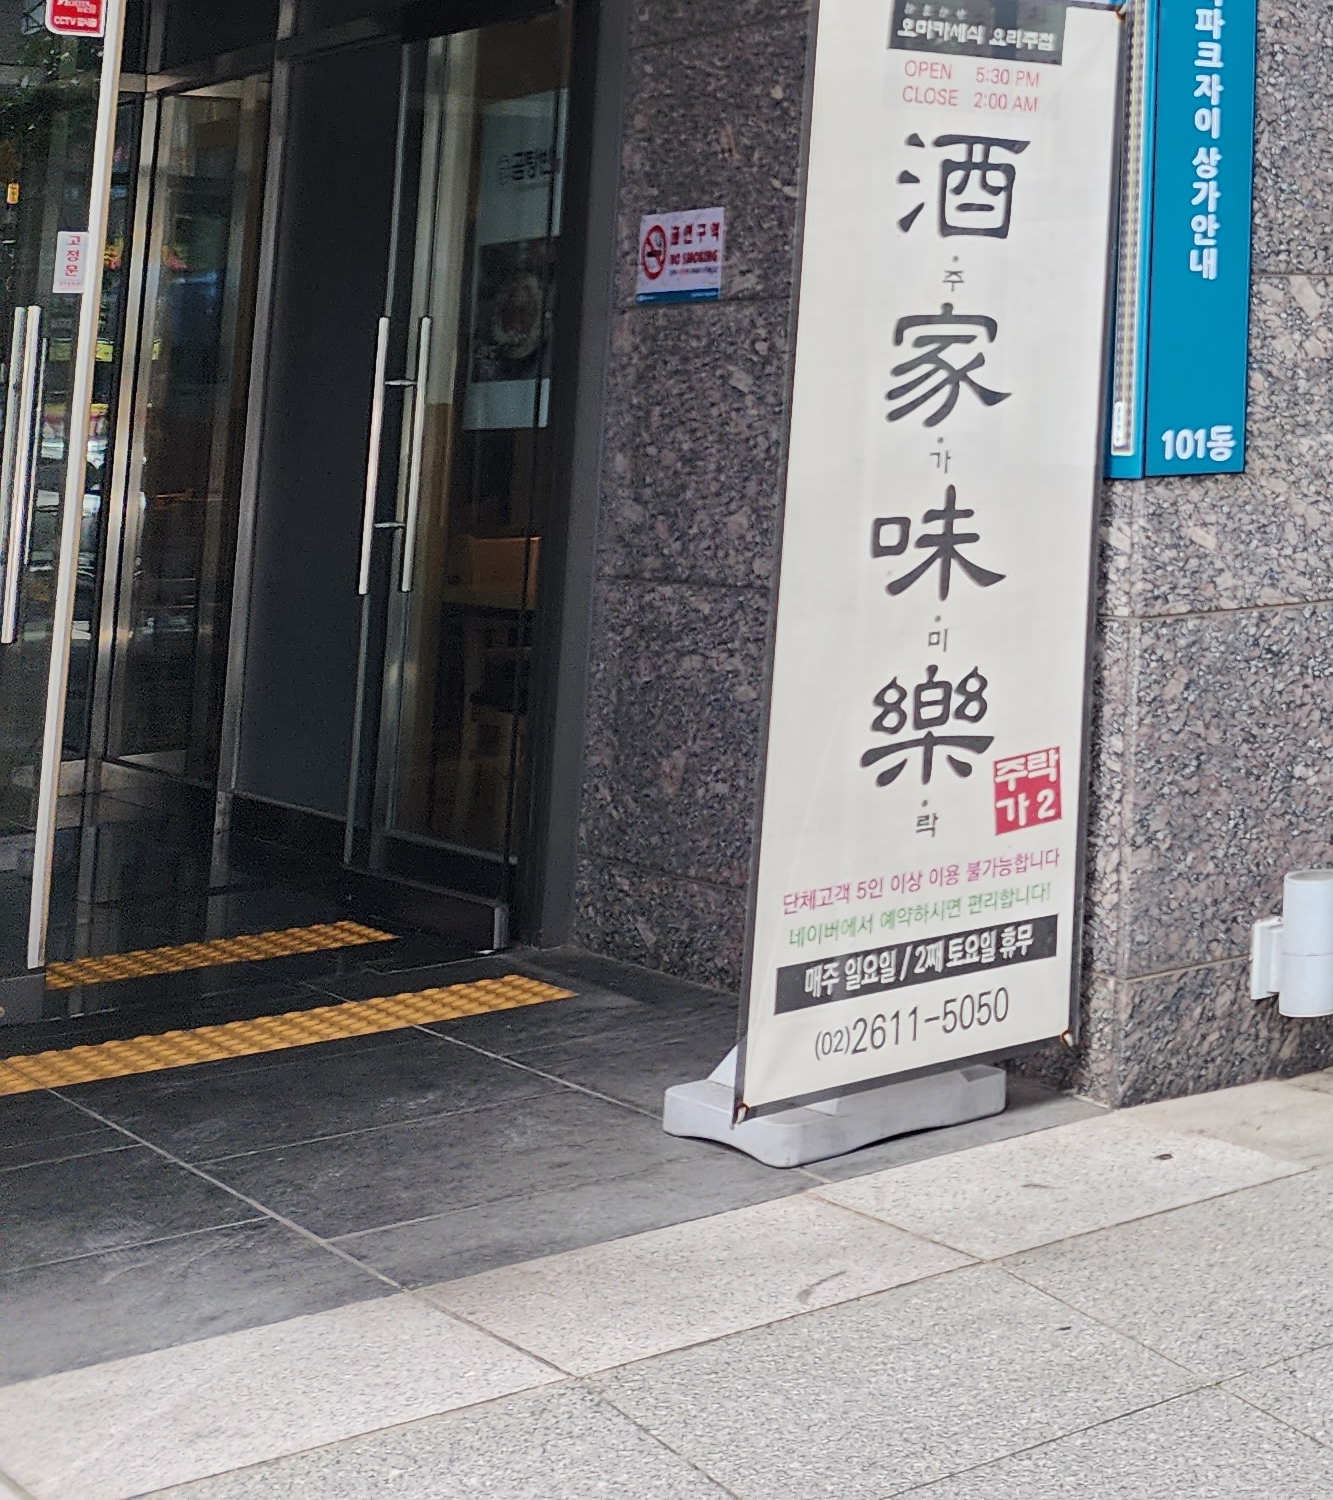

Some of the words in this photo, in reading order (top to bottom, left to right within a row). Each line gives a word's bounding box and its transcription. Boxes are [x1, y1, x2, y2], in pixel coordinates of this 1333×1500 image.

[897, 18, 986, 45] 오마카세식
[988, 27, 1056, 52] 요리주점
[905, 60, 953, 82] OPEN
[976, 67, 1010, 87] 5:30
[1014, 70, 1041, 89] PM
[903, 86, 958, 108] CLOSE
[974, 92, 1008, 112] 2:00
[1012, 94, 1039, 113] AM
[1188, 148, 1222, 281] 상가안내
[942, 270, 966, 293] 주
[1161, 426, 1237, 463] 101동
[930, 450, 951, 475] 가
[927, 628, 949, 653] 미
[915, 811, 938, 838] 락
[783, 884, 851, 914] 단체고객
[855, 877, 884, 903] 5인
[890, 870, 922, 895] 이상
[929, 862, 960, 889] 이용
[966, 847, 1059, 883] 불가능합니다
[788, 913, 874, 948] 네이버에서
[880, 900, 963, 933] 예약하시면
[969, 881, 1052, 918] 편리합니다!
[805, 962, 839, 998] 매주
[845, 951, 895, 988] 일요일
[915, 940, 943, 976] 2째
[947, 932, 996, 967] 토요일
[1000, 921, 1034, 957] 휴무
[815, 987, 1009, 1060] (02)2611-5050
